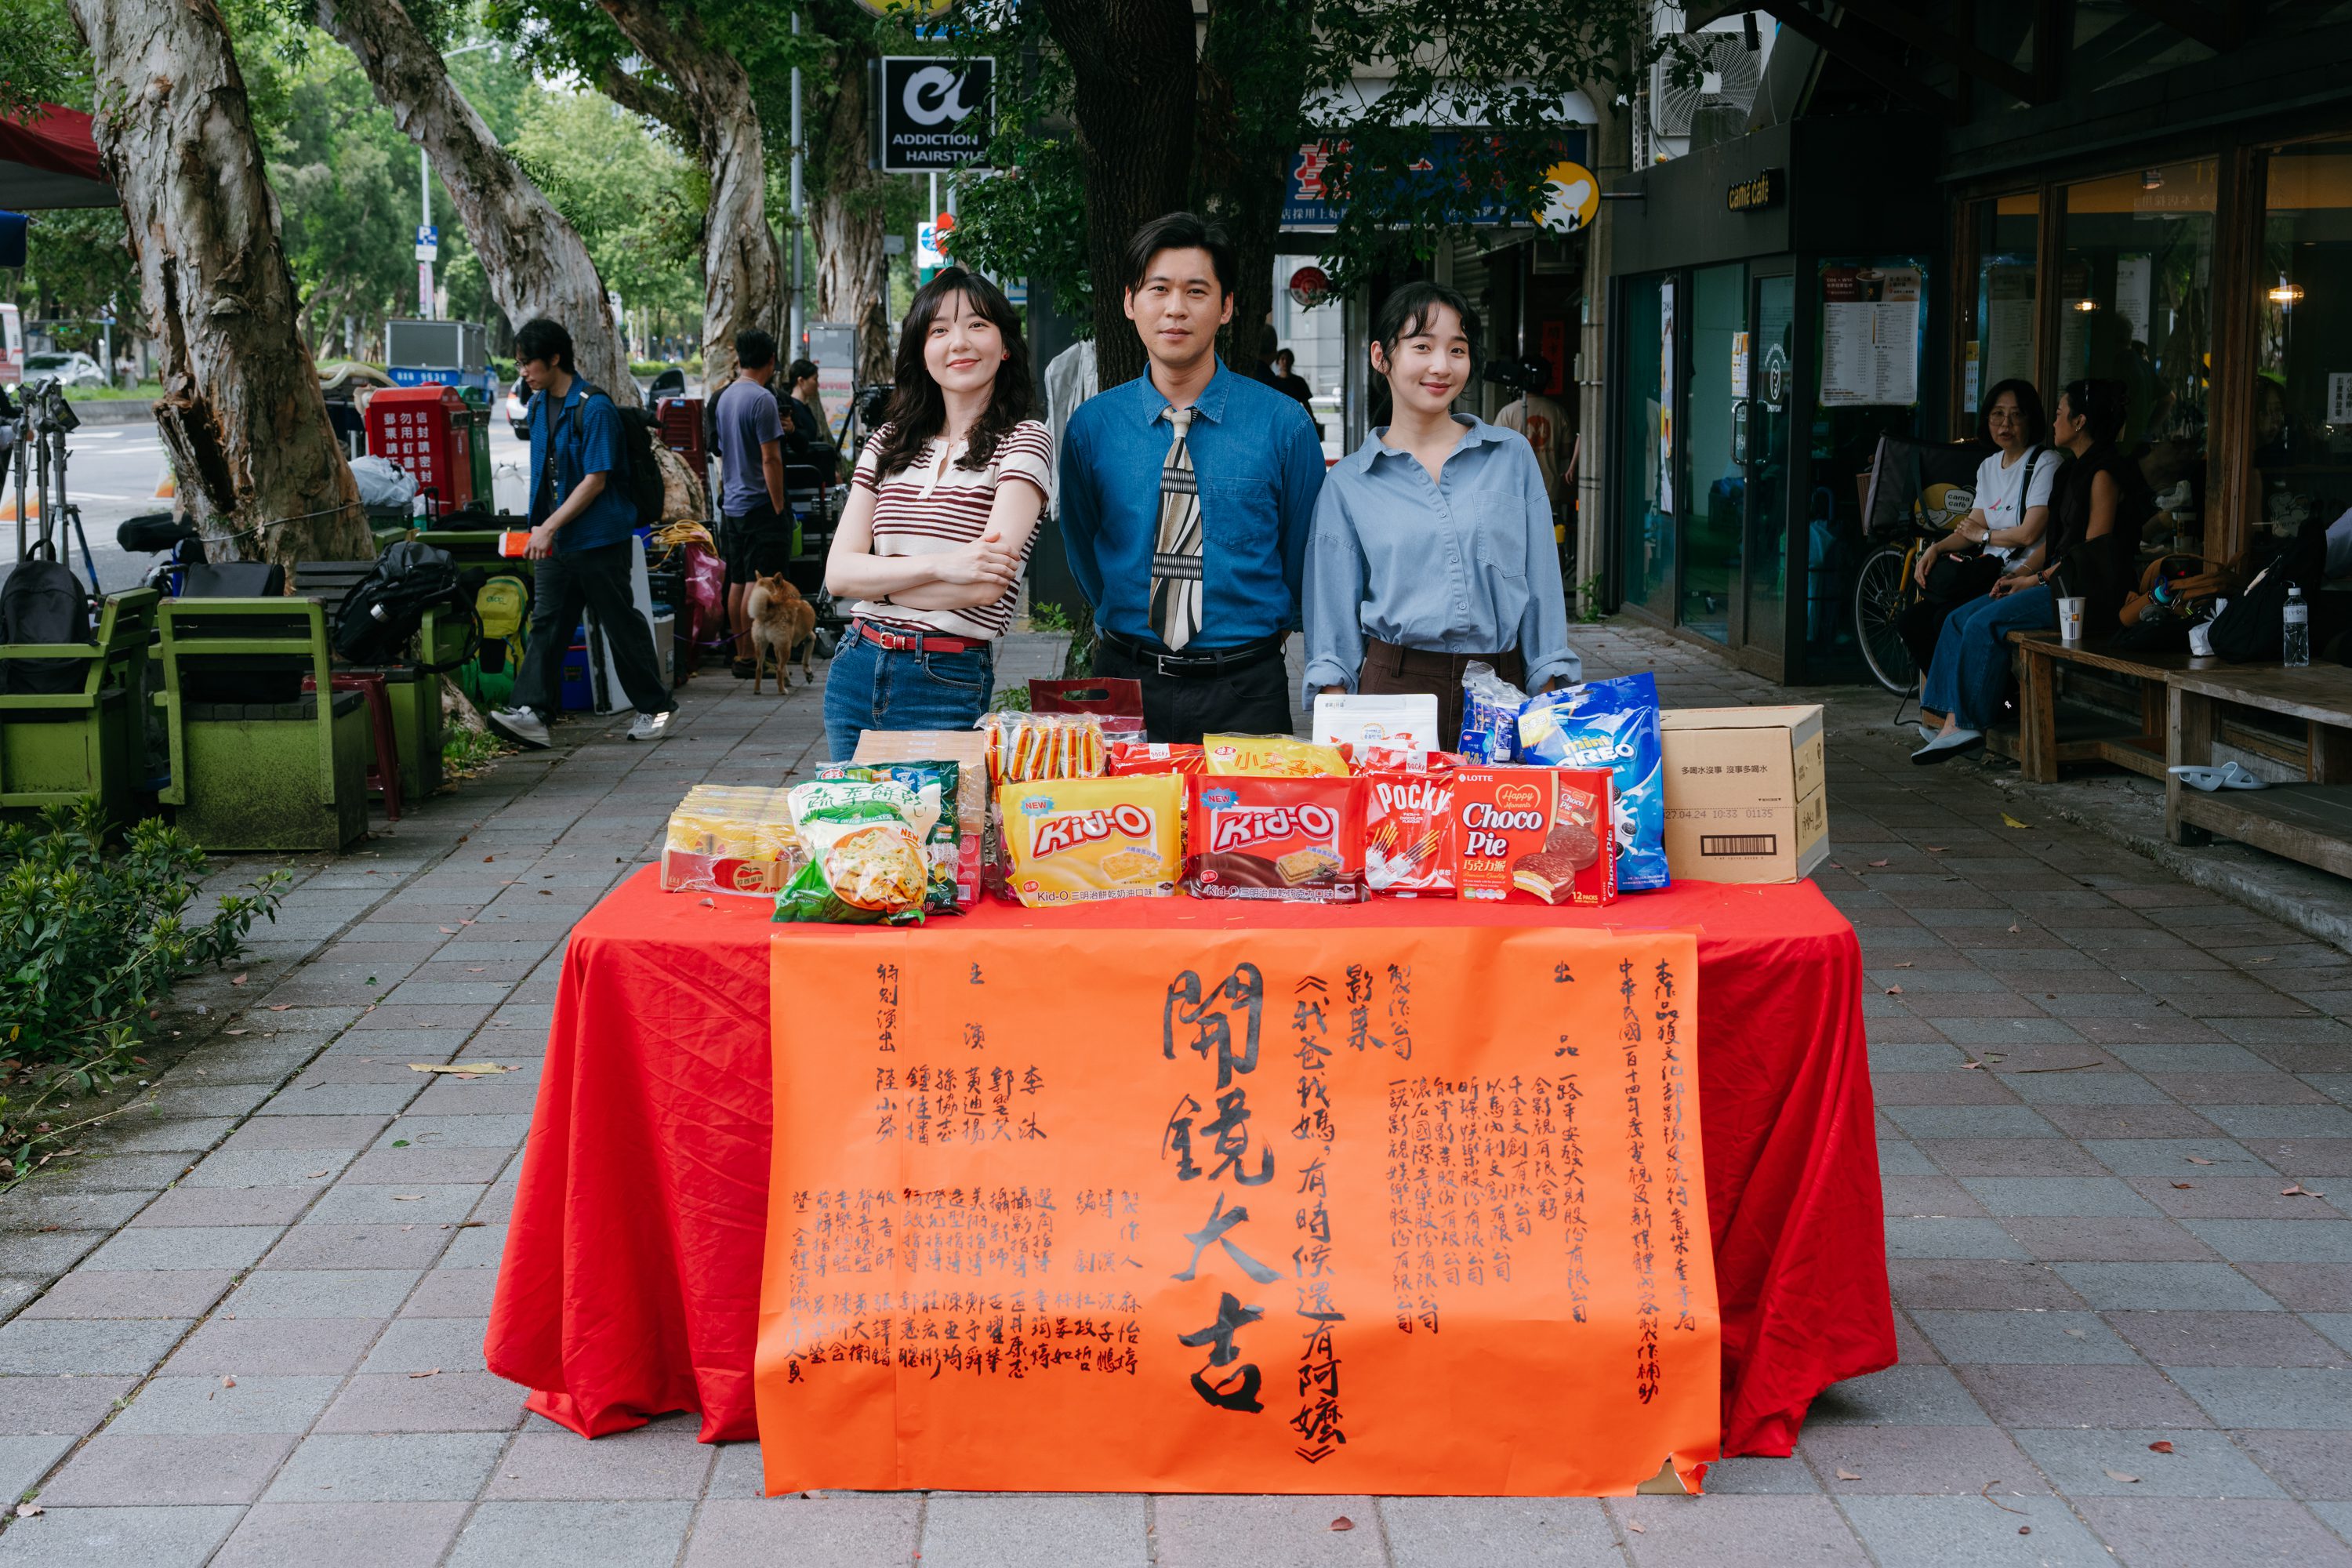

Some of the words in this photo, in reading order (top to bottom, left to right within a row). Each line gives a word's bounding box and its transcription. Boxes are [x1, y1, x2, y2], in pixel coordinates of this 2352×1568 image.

[892, 134, 978, 145] ADDICTION
[906, 151, 985, 162] HAIRSTYLE
[1729, 183, 1750, 209] cama
[419, 227, 431, 240] P
[1662, 300, 1672, 313] CAMA
[383, 412, 400, 465] 郵票請正
[399, 412, 416, 469] 勿用釘書
[416, 412, 433, 483] 信封請密封
[1947, 493, 1970, 503] cama
[1520, 714, 1548, 733] 分享包
[1562, 735, 1613, 755] mini
[1501, 790, 1534, 802] Happy
[1681, 766, 1722, 775] 多喝水沒事
[1726, 765, 1768, 774] 沒事多喝水
[863, 814, 895, 823] CRACKERS
[1025, 801, 1047, 810] NEW
[1462, 802, 1542, 830] Choco
[1559, 801, 1573, 811] Pie
[1561, 793, 1584, 807] Choco
[1713, 810, 1738, 818] 10:33
[1746, 809, 1773, 818] 01135
[900, 828, 920, 842] NEW
[1033, 804, 1151, 859] Kid-O
[1213, 802, 1336, 854] Kid-O
[1464, 831, 1508, 857] Pie
[1024, 883, 1038, 892] 奶素
[1463, 859, 1507, 872] 巧克力派
[1037, 891, 1069, 902] Kid-O
[1071, 888, 1154, 901] 三明治餅乾奶油口味
[1207, 885, 1239, 896] Kid-O
[1240, 887, 1334, 899] 三明治餅乾巧克力口味
[1573, 891, 1582, 900] 12
[876, 963, 900, 1053] 特別演出
[963, 962, 985, 1050] 主演
[1345, 964, 1388, 1052] 影集
[1387, 963, 1412, 1061] 製作公司
[876, 1067, 898, 1145] 陸小芬
[935, 1067, 958, 1143] 孫協志
[963, 1066, 986, 1145] 黃迪揚
[1018, 1065, 1047, 1140] 李沐
[1161, 962, 1289, 1414] 開鏡大吉
[833, 1189, 853, 1273] 音樂總監
[855, 1188, 875, 1273] 聲音總監
[876, 1190, 898, 1271] 收音師
[945, 1188, 967, 1275] 造型指導
[966, 1186, 988, 1277] 美術指導
[989, 1187, 1010, 1271] 攝影師
[1010, 1186, 1033, 1278] 攝影指導
[1033, 1187, 1057, 1274] 選角指導
[1073, 1189, 1096, 1273] 編劇
[1098, 1188, 1116, 1273] 導演
[1120, 1189, 1143, 1269] 製作人
